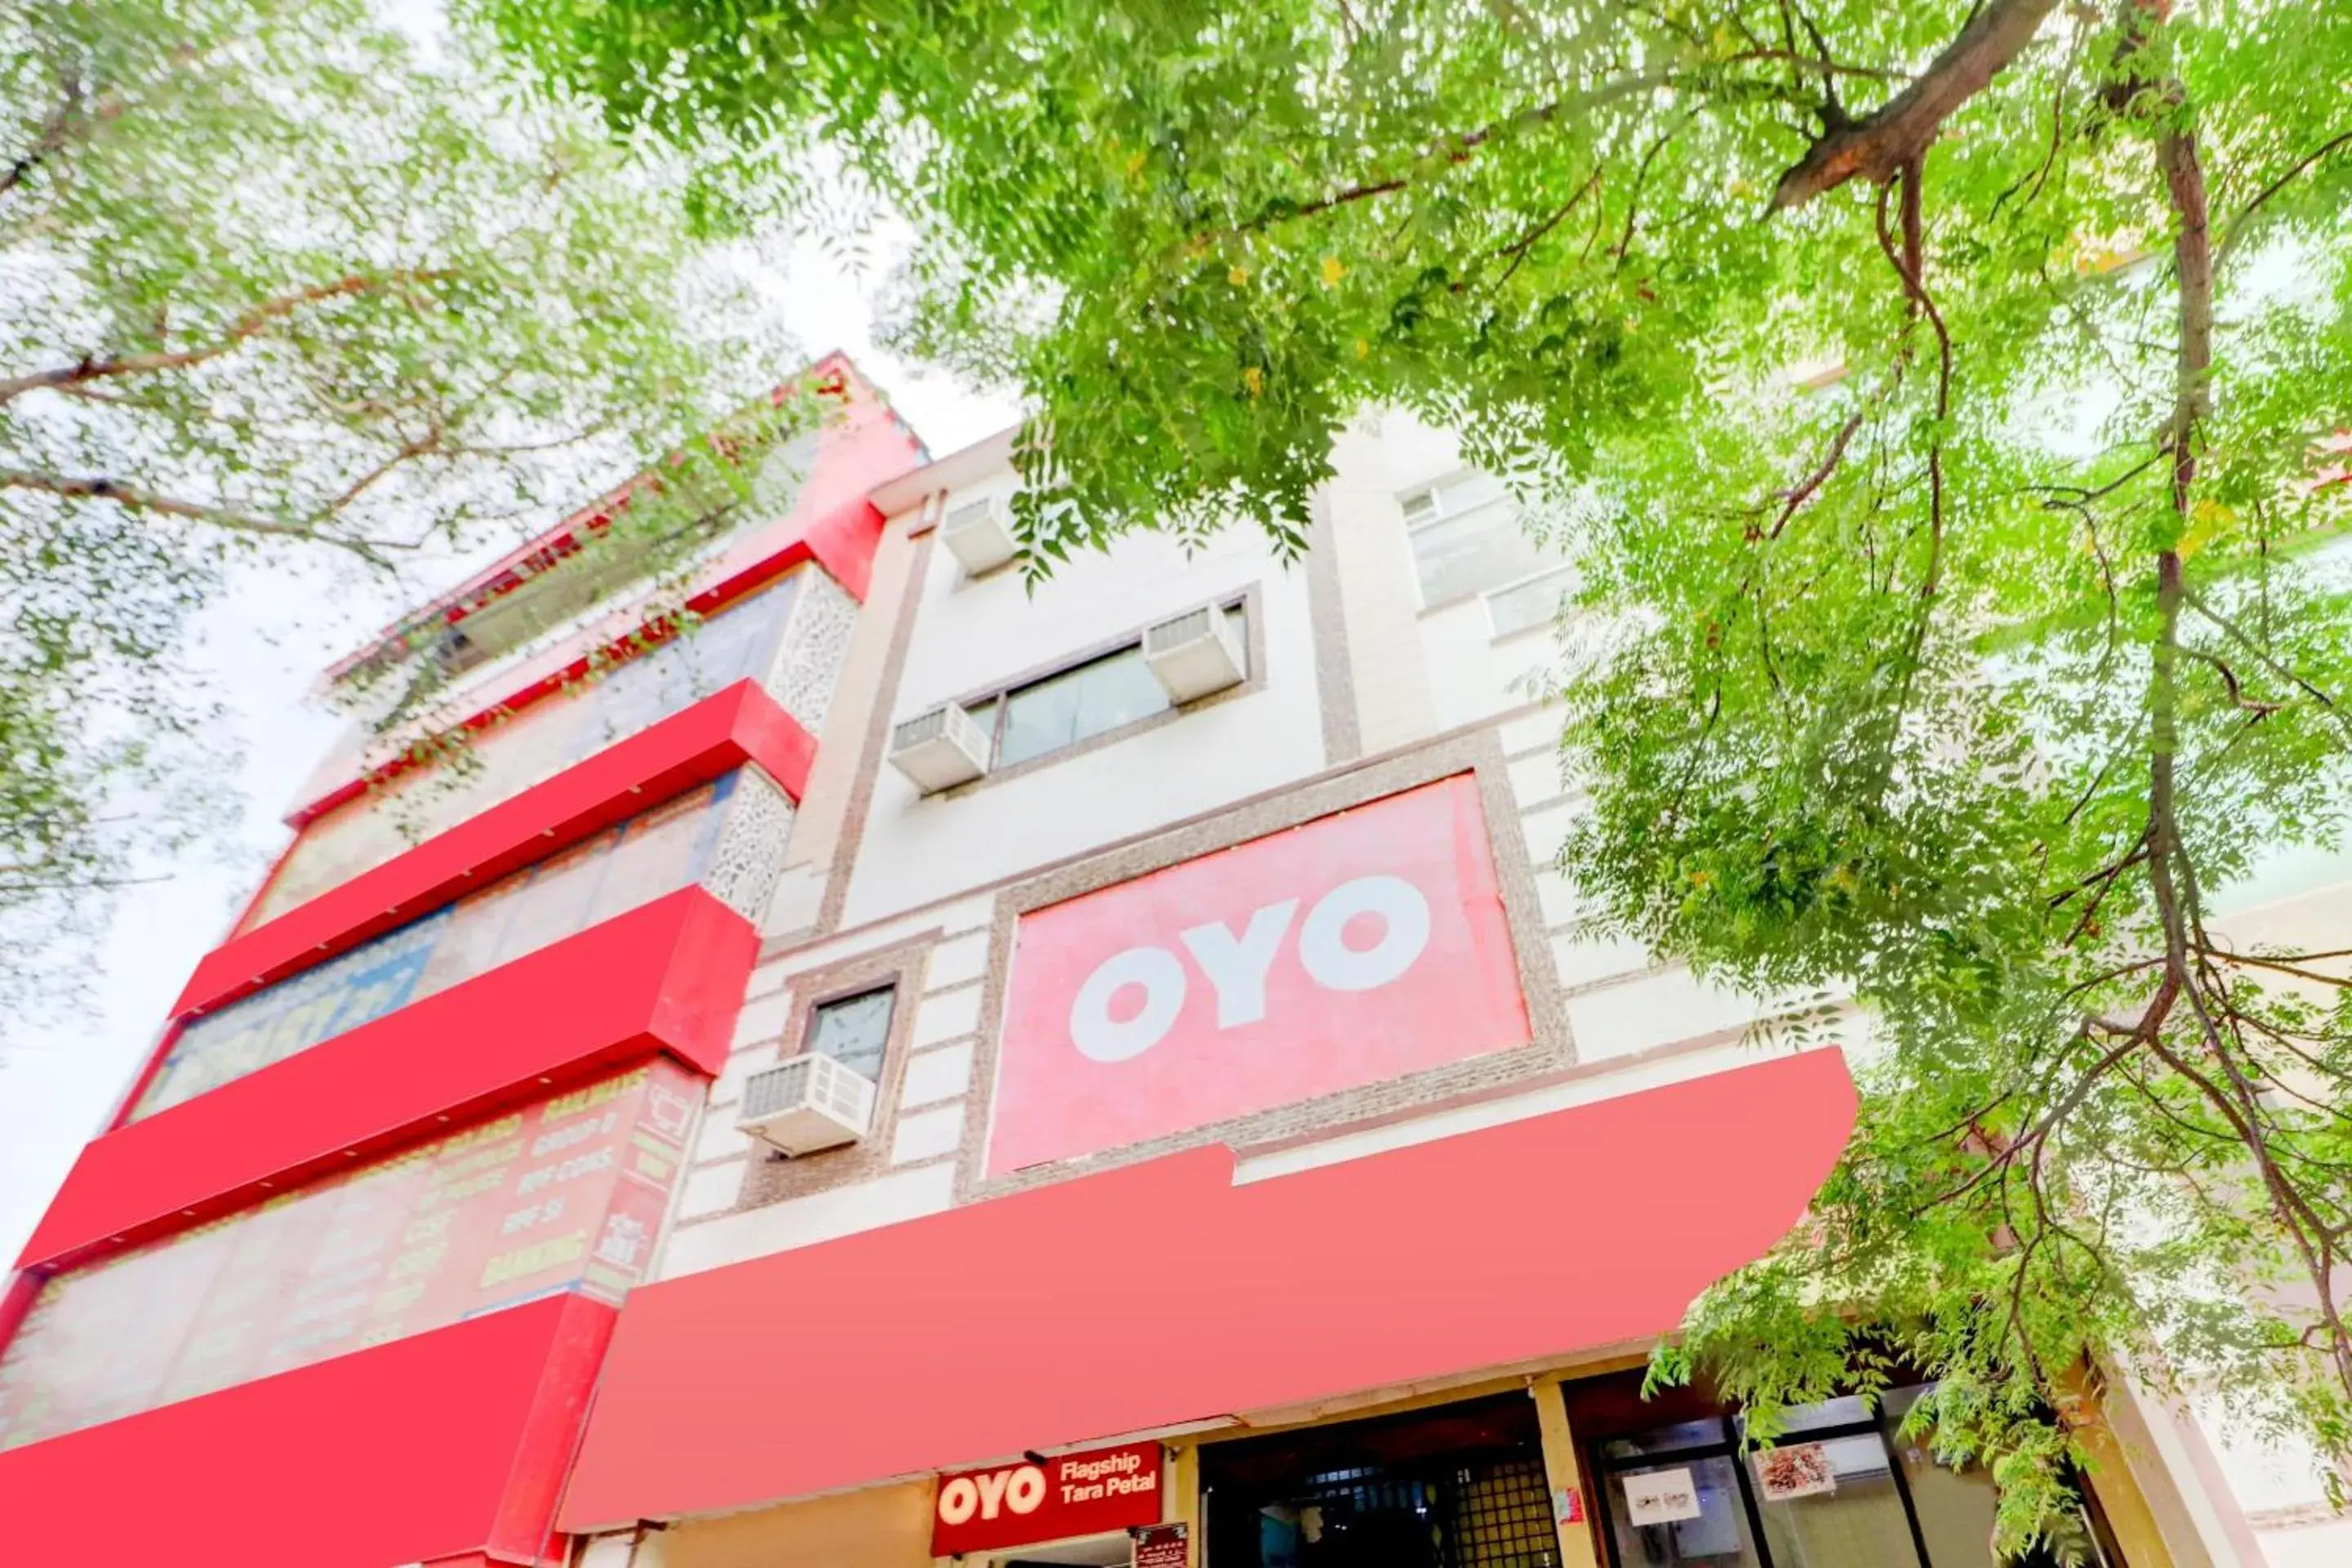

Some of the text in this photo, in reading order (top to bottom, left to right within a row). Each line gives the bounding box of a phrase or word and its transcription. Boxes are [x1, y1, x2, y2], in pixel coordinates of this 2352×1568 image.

[1070, 875, 1431, 1063] OYO
[1060, 1452, 1141, 1481] Flagship
[1060, 1470, 1156, 1504] Tara Petal
[938, 1466, 1046, 1526] OYO
